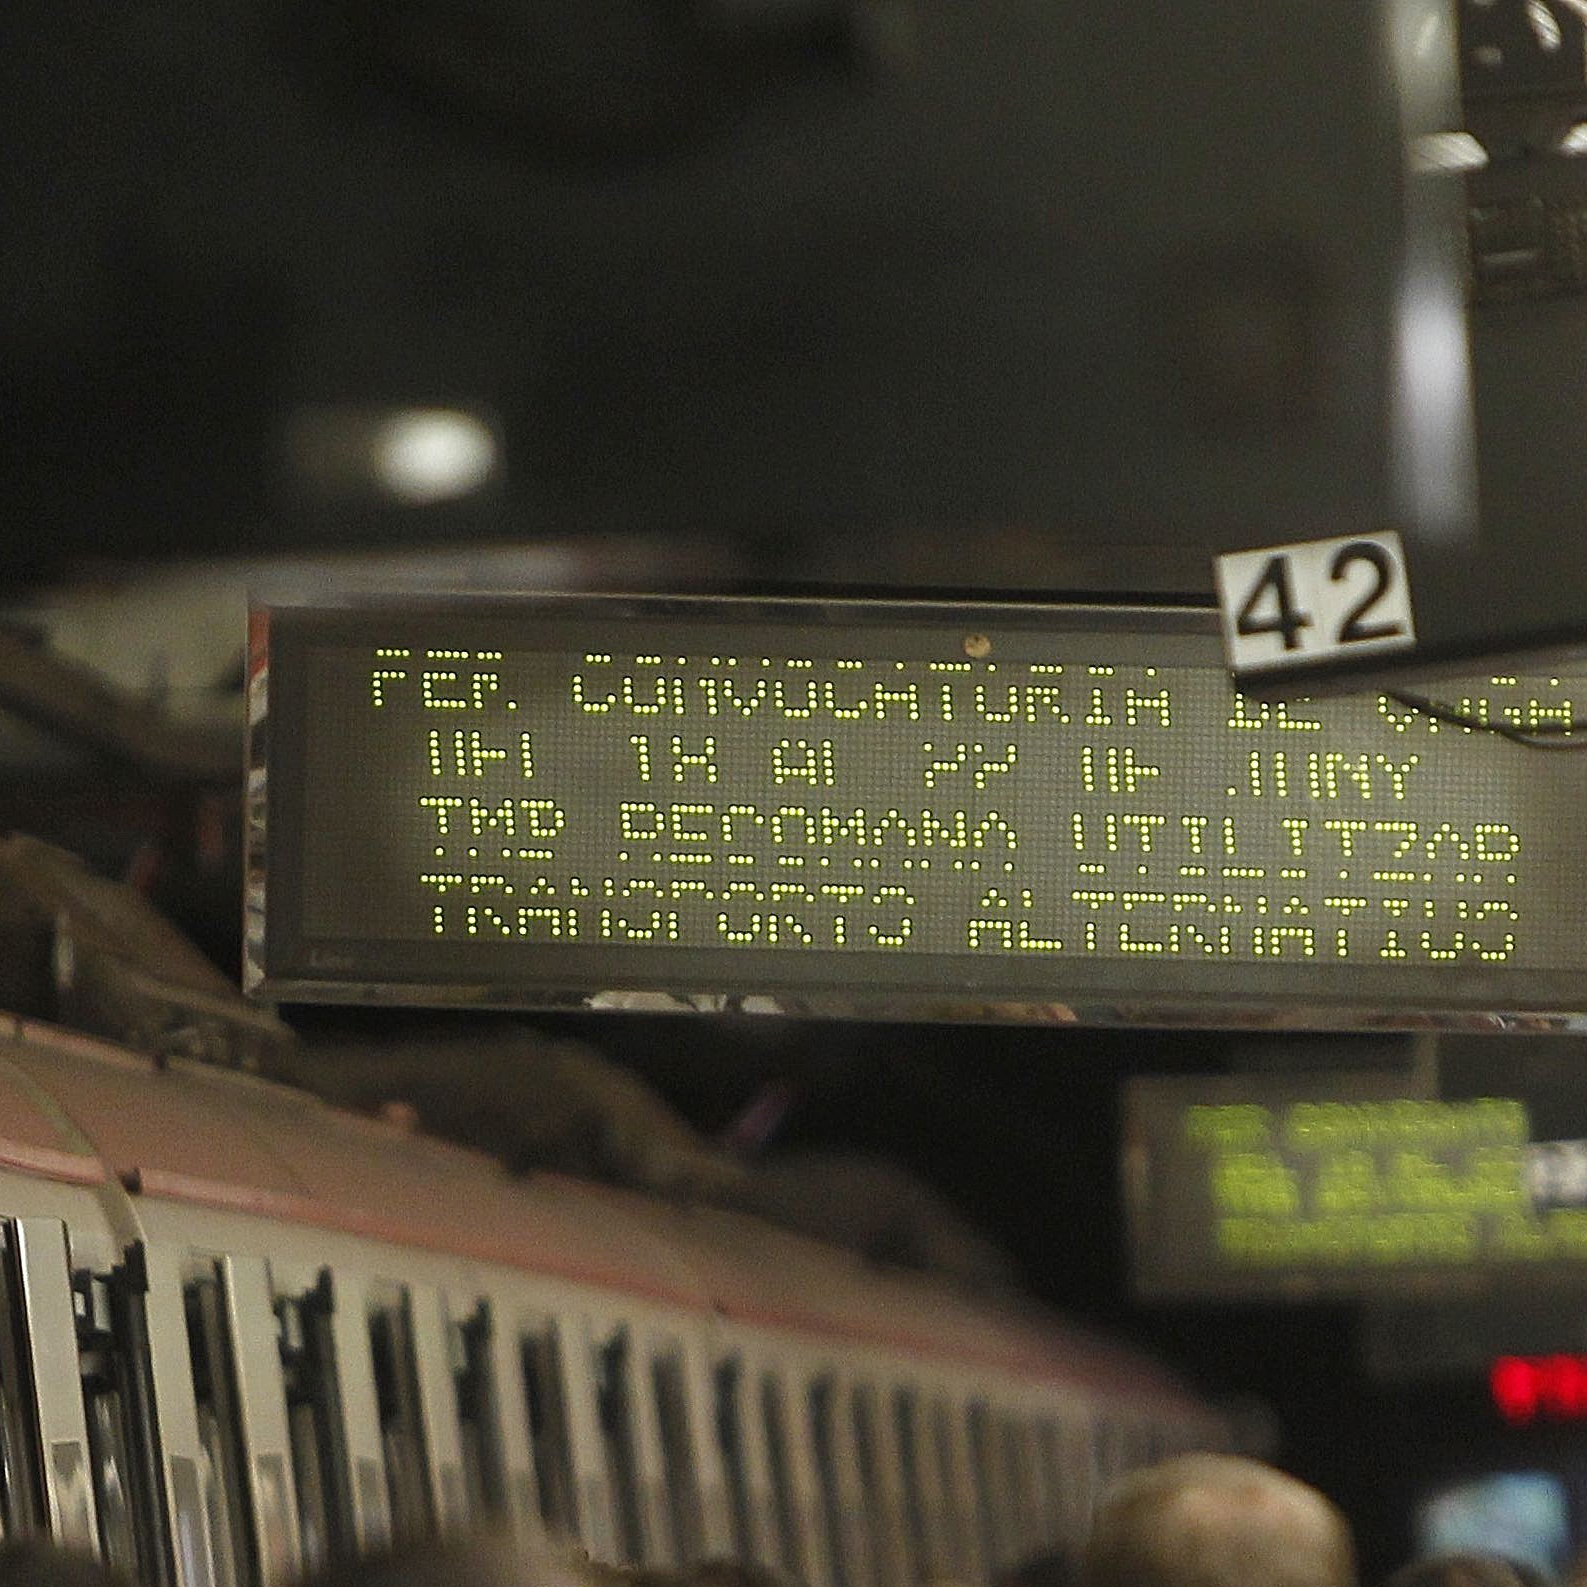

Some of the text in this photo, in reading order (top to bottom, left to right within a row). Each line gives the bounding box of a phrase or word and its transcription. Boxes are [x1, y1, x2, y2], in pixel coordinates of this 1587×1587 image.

[1238, 540, 1403, 651] 42
[618, 802, 1018, 872] RECOMANA
[1072, 812, 1520, 884] UTILITZAR
